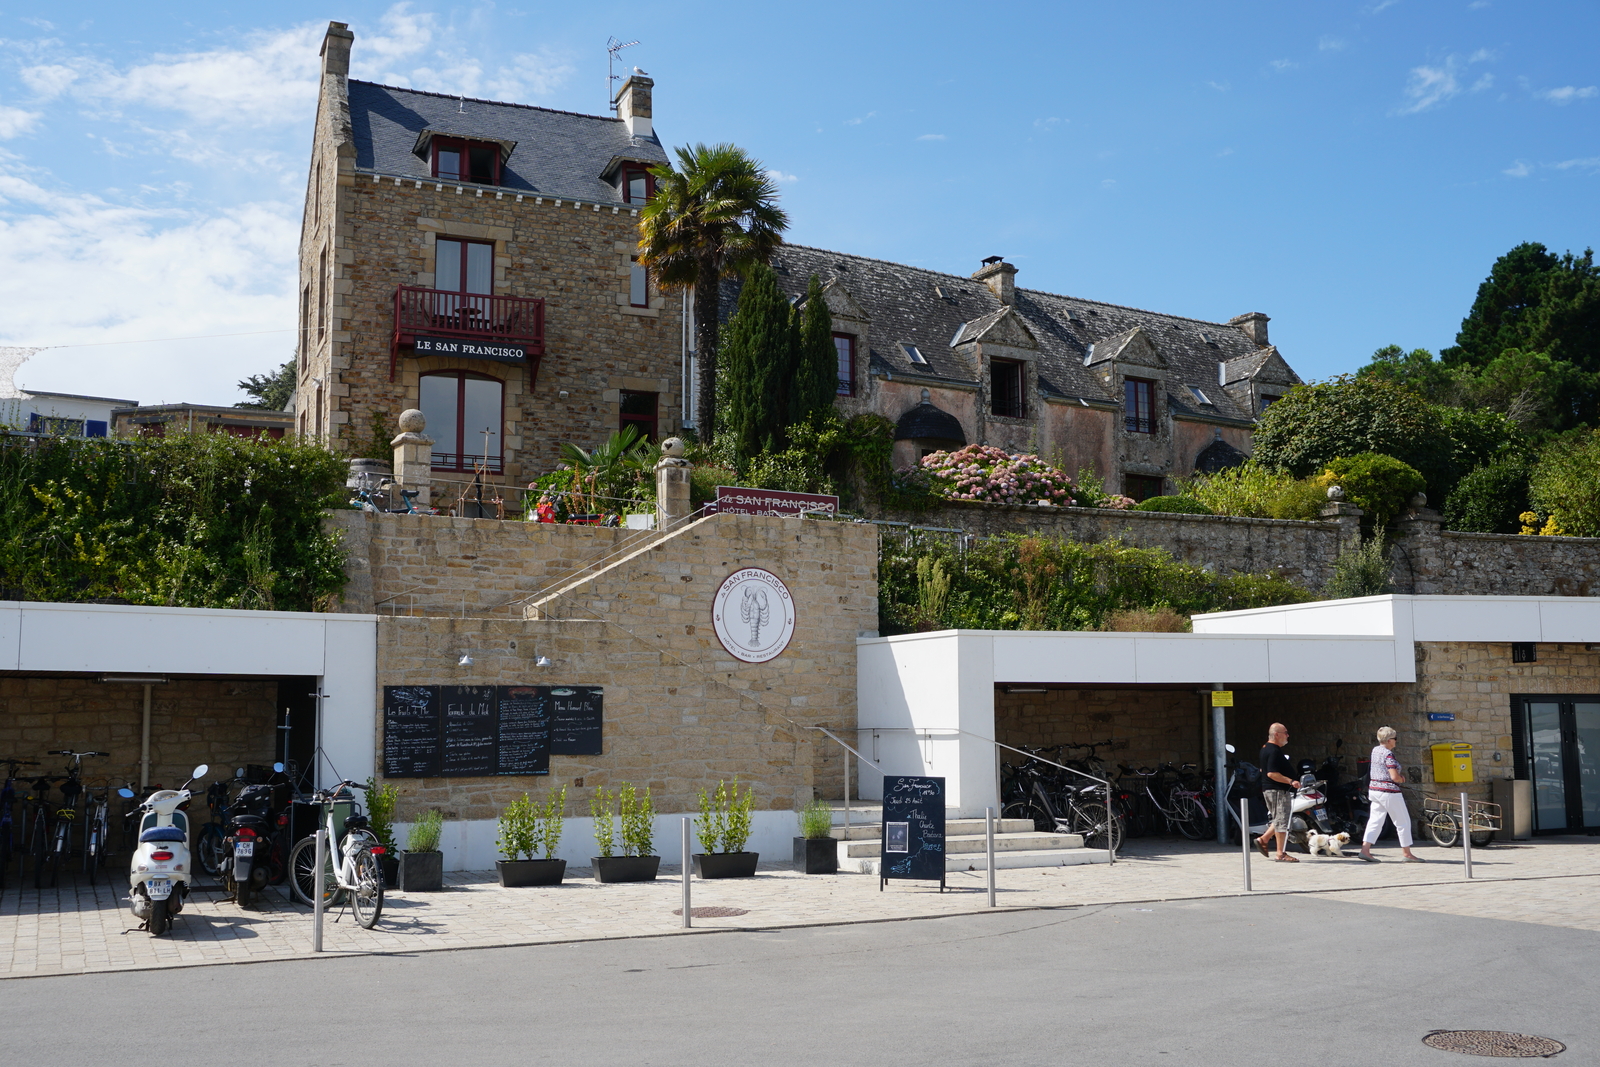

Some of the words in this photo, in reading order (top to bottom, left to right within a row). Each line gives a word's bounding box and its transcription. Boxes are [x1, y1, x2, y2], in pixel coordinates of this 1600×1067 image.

[416, 340, 431, 350] LE
[435, 342, 459, 352] SAN
[462, 344, 524, 358] FRANCISCO
[736, 495, 762, 506] SAN
[765, 497, 835, 512] FRANCISCO
[723, 576, 740, 592] SAN
[741, 570, 789, 600] FRANCISCO
[756, 640, 785, 659] RESTAURANT
